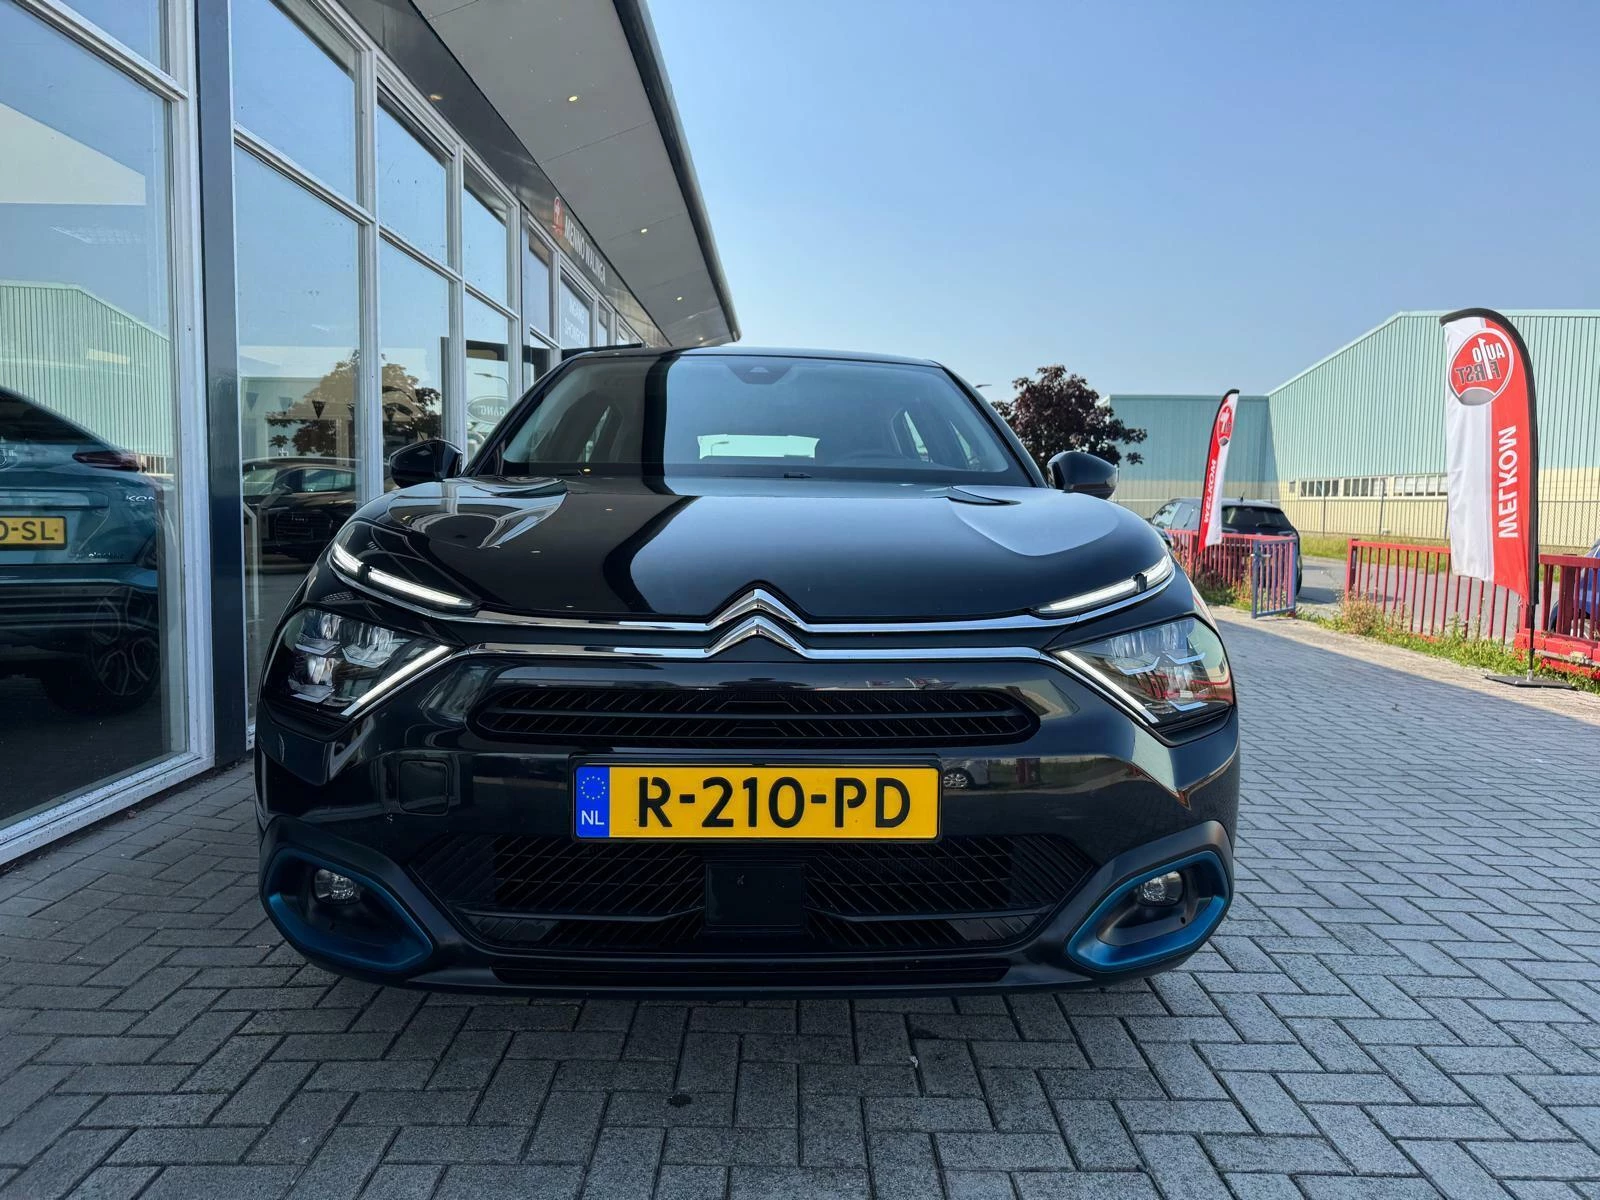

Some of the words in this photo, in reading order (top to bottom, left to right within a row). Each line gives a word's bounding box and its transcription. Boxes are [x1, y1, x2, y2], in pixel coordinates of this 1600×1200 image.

[1204, 459, 1217, 523] WELKOM
[581, 809, 605, 826] NL
[637, 776, 911, 829] R-210-PD
